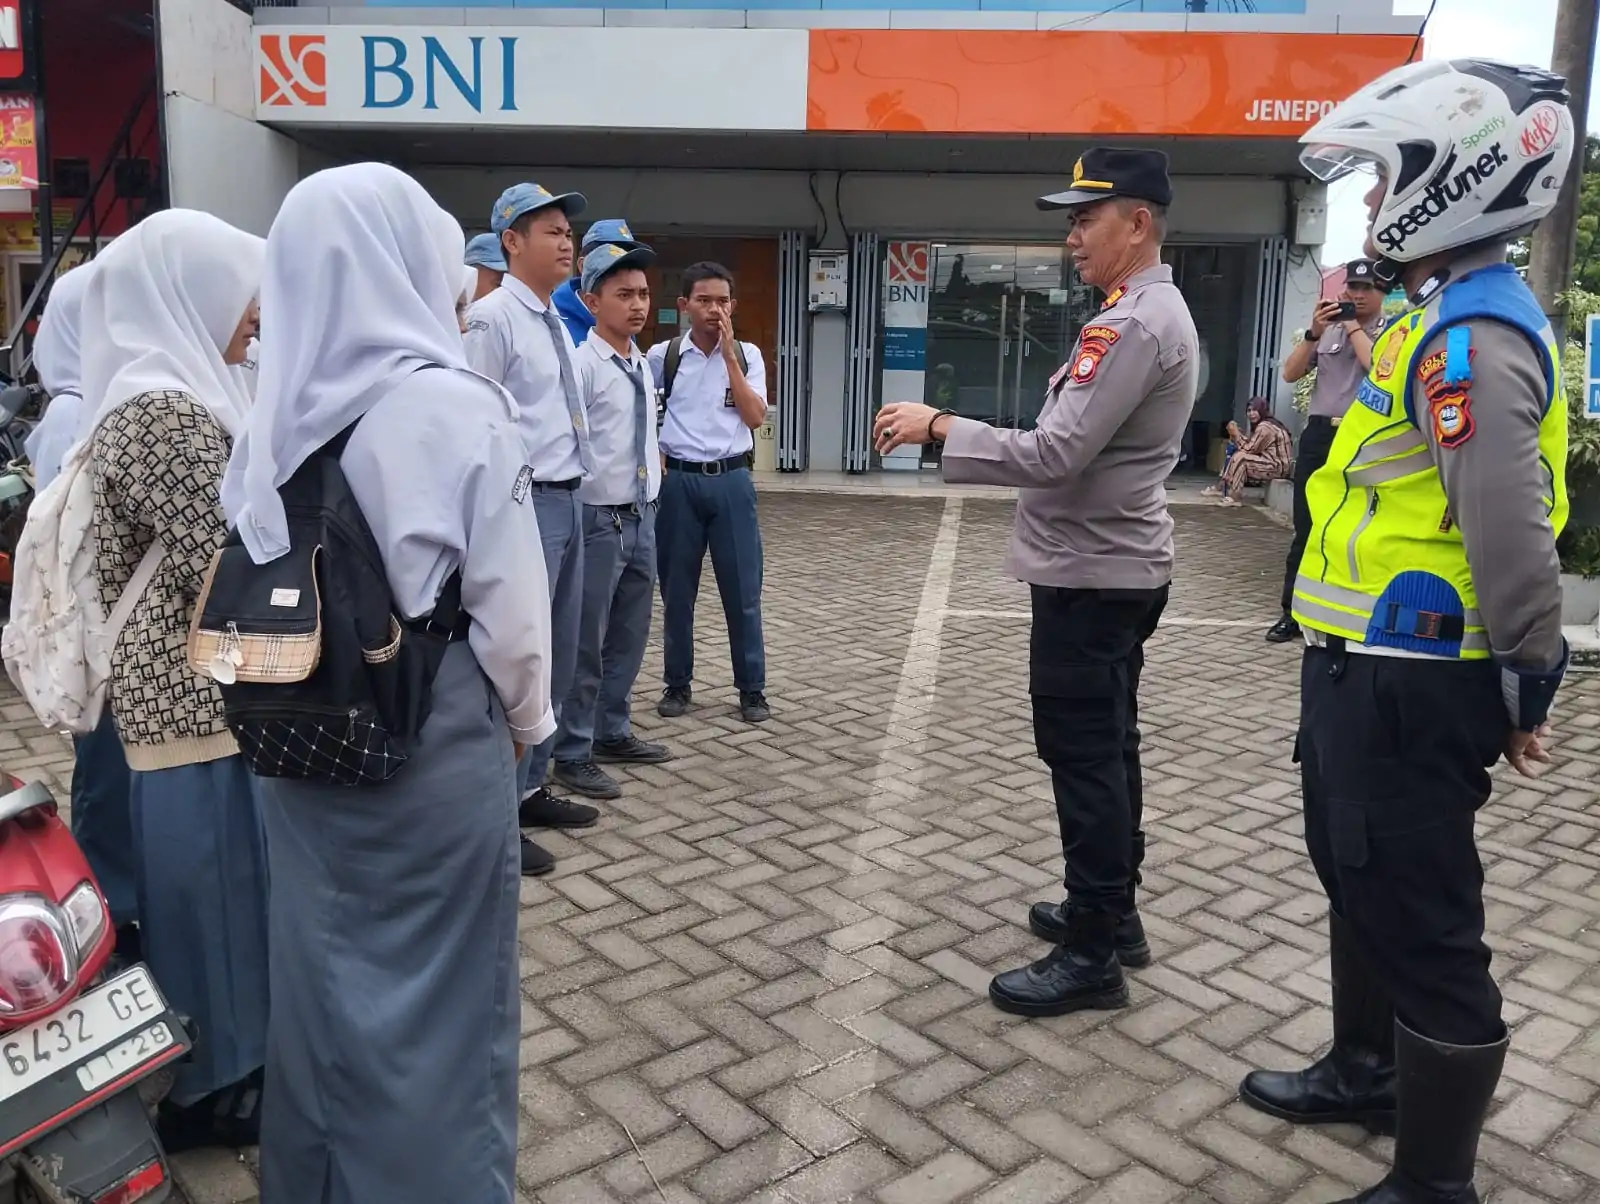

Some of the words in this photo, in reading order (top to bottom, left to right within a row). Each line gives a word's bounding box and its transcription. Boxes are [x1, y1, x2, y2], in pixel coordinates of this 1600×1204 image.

[361, 36, 520, 114] BNI
[1461, 115, 1507, 150] Spotify
[888, 285, 926, 303] BNI
[1357, 383, 1386, 411] OLRI
[3, 1008, 93, 1077] 6432
[107, 977, 155, 1021] GE
